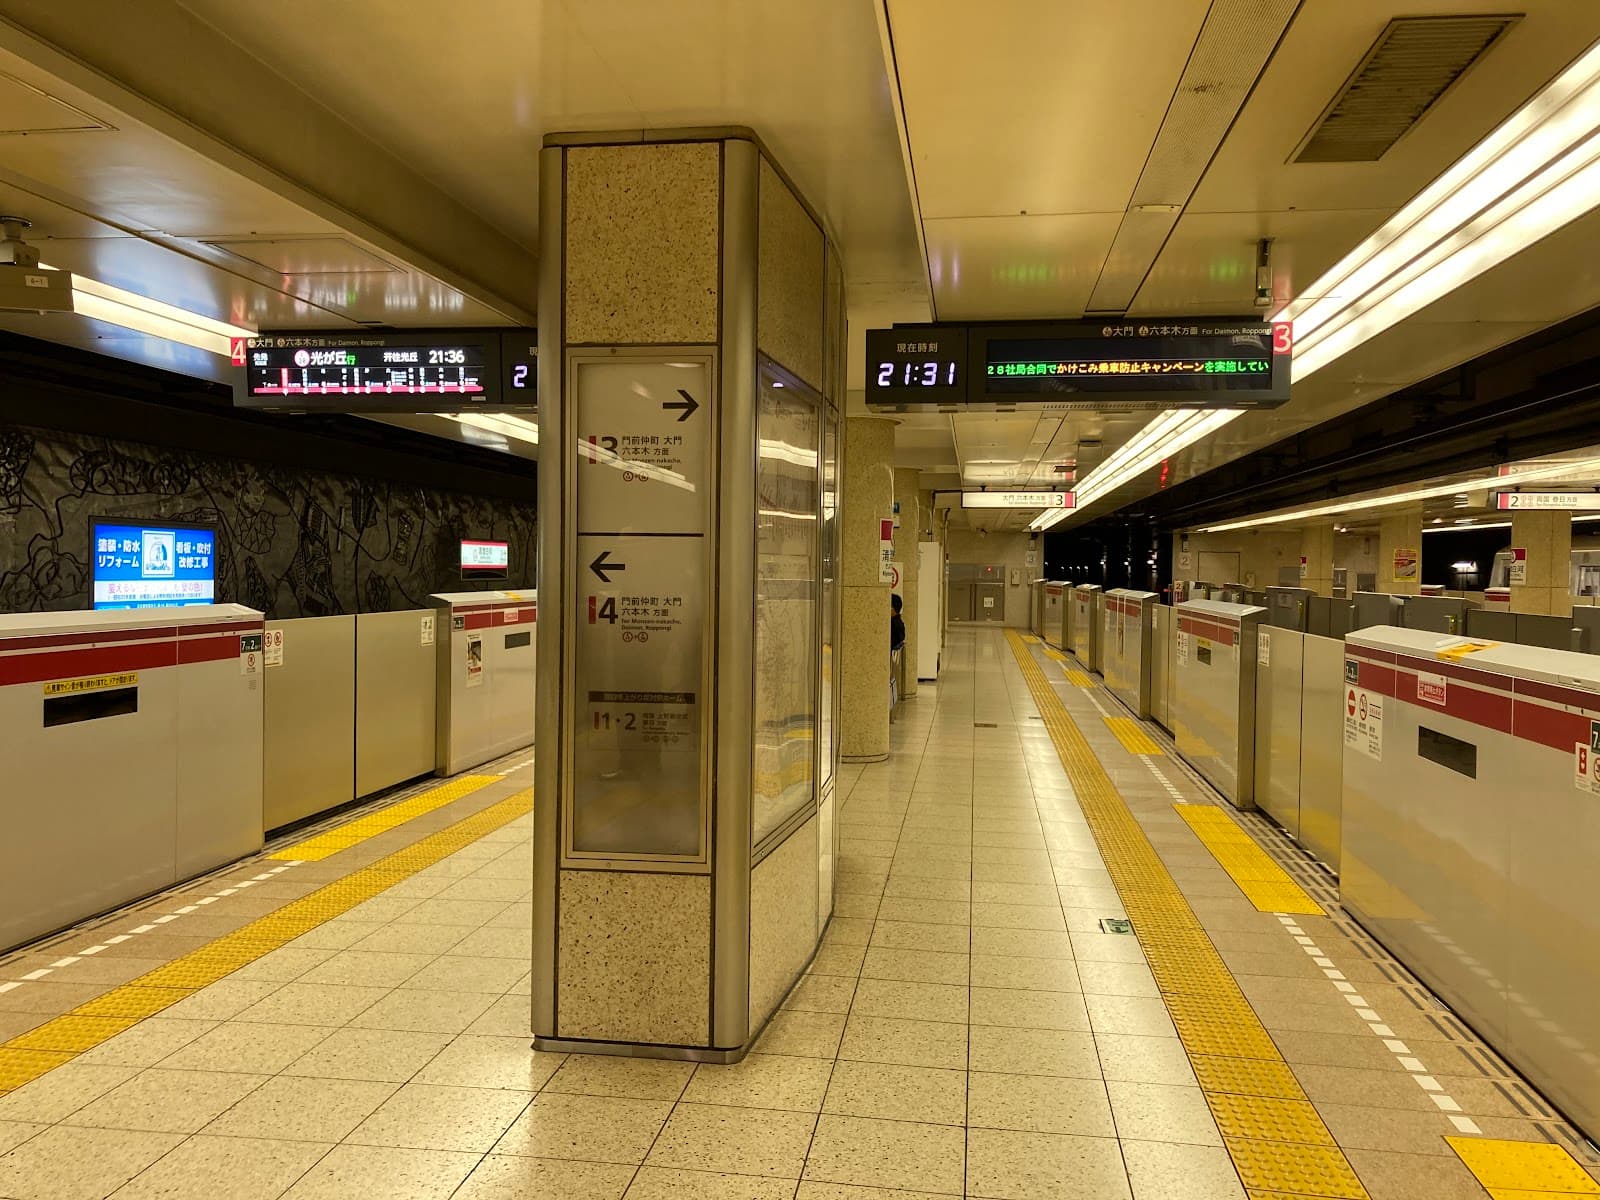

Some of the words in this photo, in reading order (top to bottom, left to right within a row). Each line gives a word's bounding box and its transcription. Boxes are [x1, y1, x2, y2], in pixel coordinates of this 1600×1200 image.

[1113, 326, 1133, 336] 大門
[256, 338, 274, 347] 大門
[1274, 325, 1290, 353] 3
[231, 340, 246, 364] 4
[896, 342, 938, 353] 現在時刻
[429, 351, 465, 364] 21:36
[513, 366, 528, 388] 2
[878, 362, 956, 386] 21:31
[622, 436, 660, 446] 門前仲町
[664, 436, 682, 446] 大門
[601, 436, 618, 464] 3
[622, 447, 650, 456] 六本木
[1056, 494, 1063, 506] 3
[1510, 495, 1519, 507] 2
[98, 555, 140, 569] リフォーム
[622, 597, 659, 607] 門前仲町
[664, 597, 682, 607] 大門
[598, 597, 618, 625] 4
[622, 608, 650, 616] 六本木
